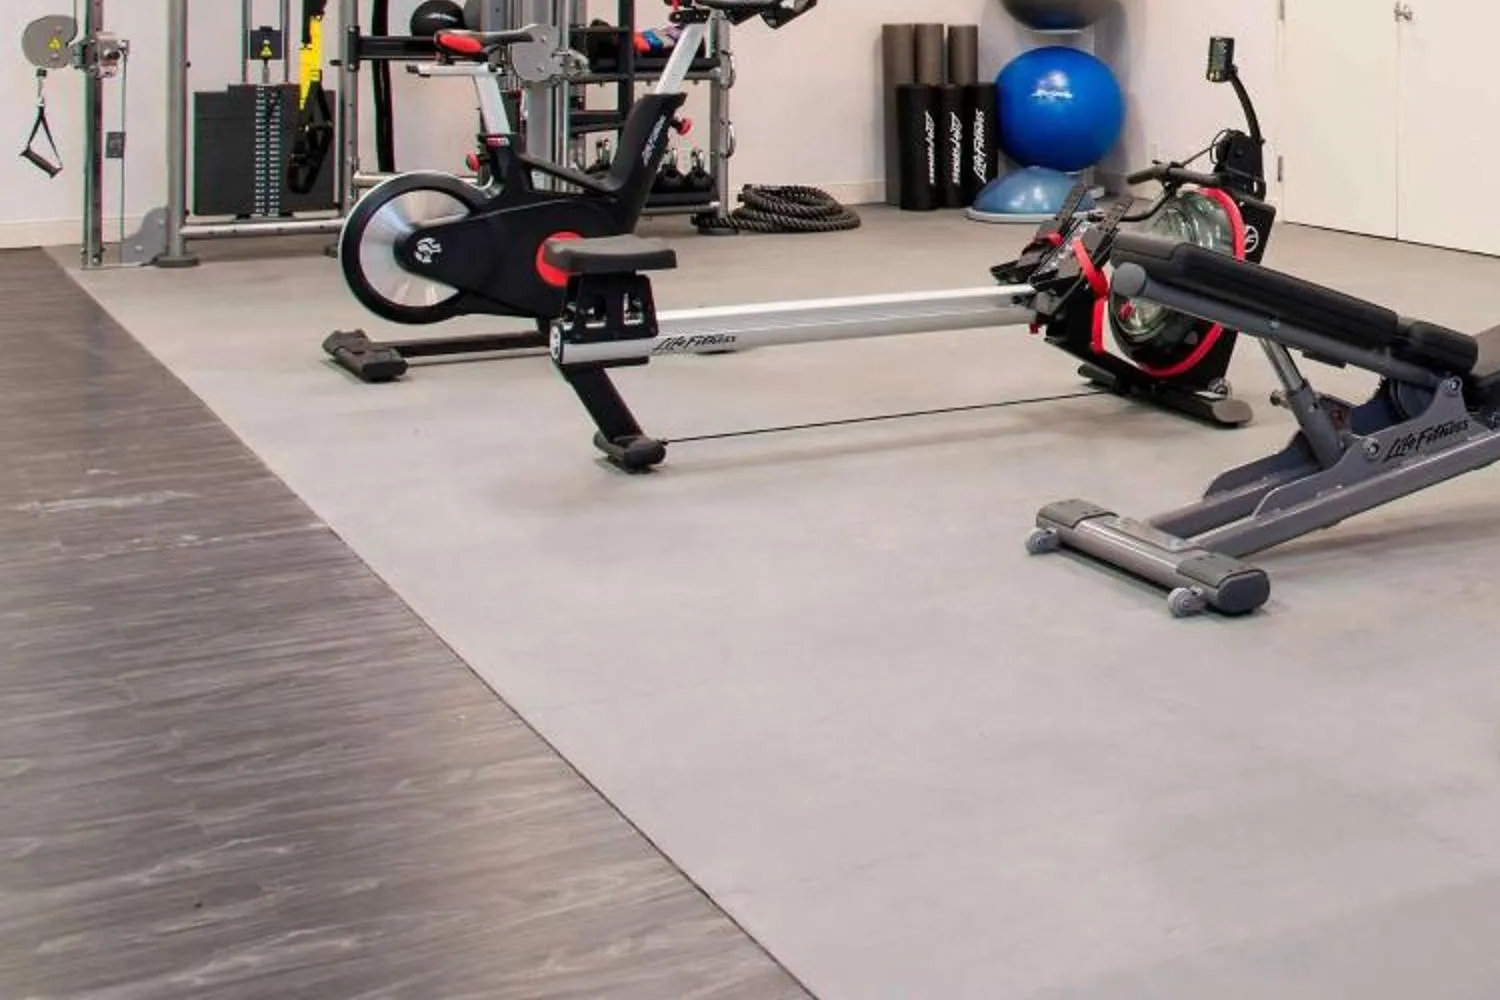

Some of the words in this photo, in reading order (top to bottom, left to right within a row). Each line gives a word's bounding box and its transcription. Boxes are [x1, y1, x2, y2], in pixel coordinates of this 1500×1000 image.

[652, 336, 687, 351] Life
[1383, 433, 1417, 462] Life
[1415, 419, 1470, 452] Fitness
